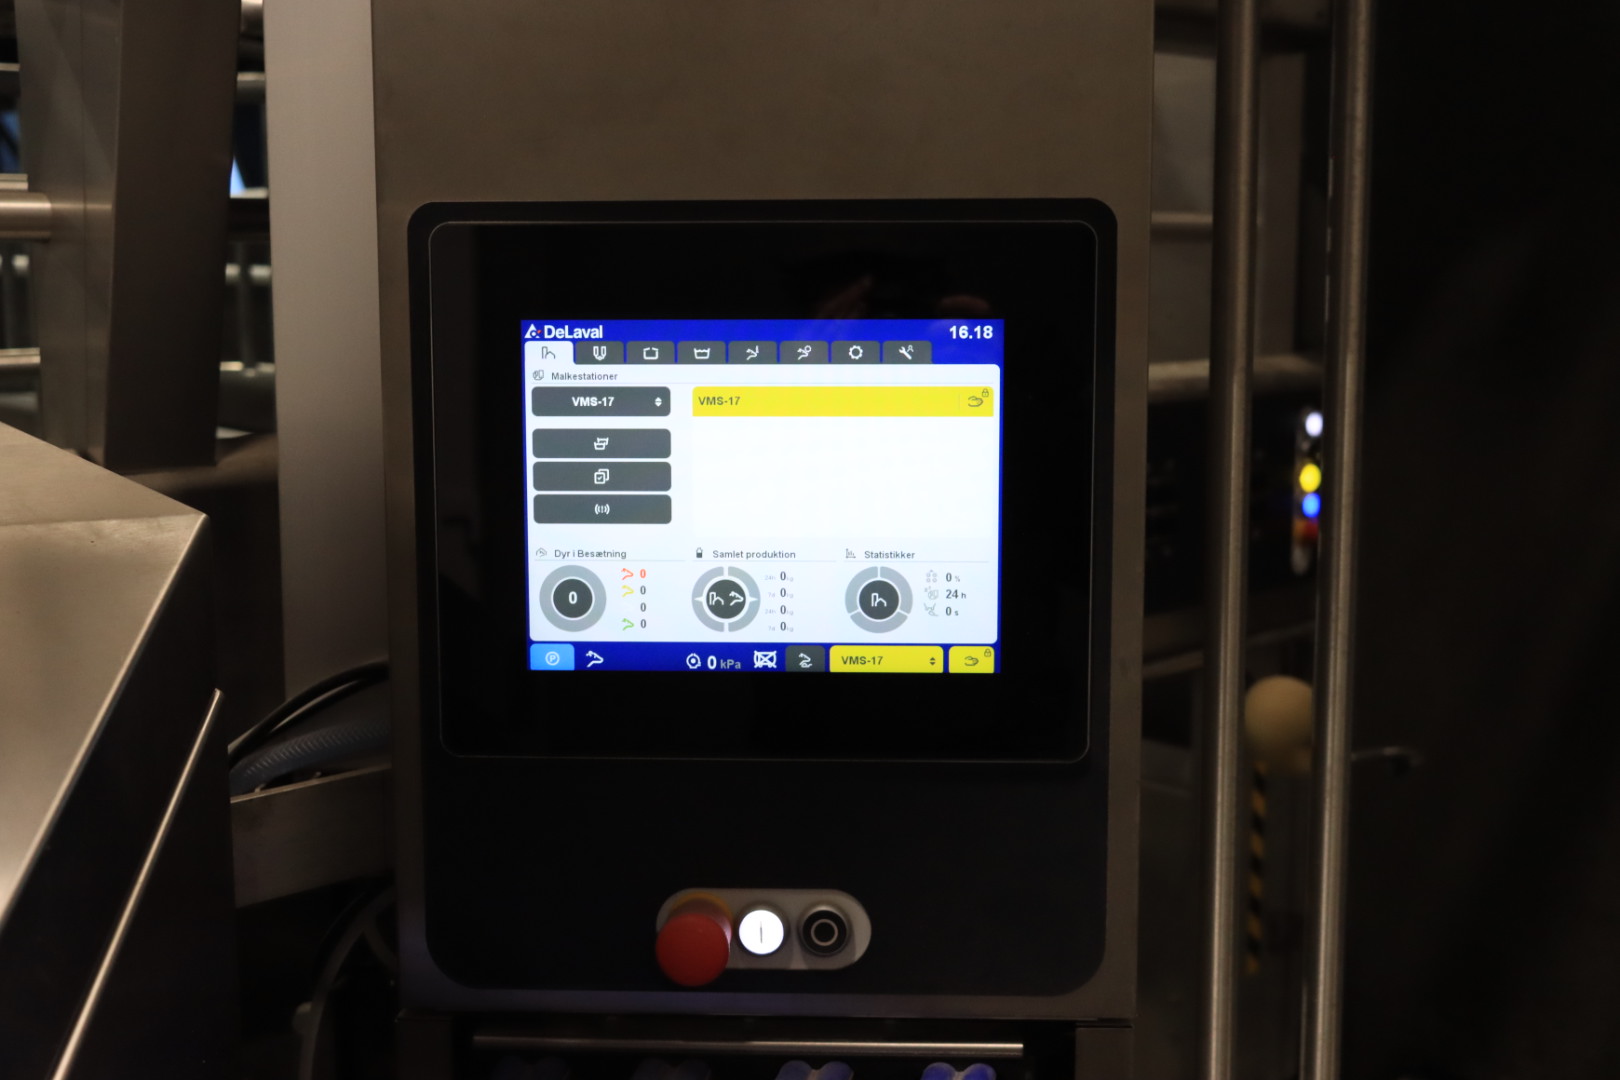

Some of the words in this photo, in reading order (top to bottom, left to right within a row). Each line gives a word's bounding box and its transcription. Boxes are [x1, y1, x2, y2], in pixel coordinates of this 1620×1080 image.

[544, 325, 603, 339] DeLaval
[949, 325, 993, 339] 16.18
[551, 371, 618, 381] Malkestationer
[572, 396, 615, 407] VMS-17
[698, 396, 741, 406] VMS-17
[554, 550, 571, 559] Dyr
[578, 549, 627, 559] Besætning
[713, 550, 744, 559] Samlet
[746, 550, 796, 560] produktion
[864, 550, 915, 559] Statistikker
[640, 569, 646, 578] 0
[780, 571, 786, 581] 0
[945, 572, 952, 582] 0
[640, 585, 646, 595] 0
[780, 588, 786, 598] 0
[945, 589, 959, 599] 24
[568, 591, 578, 605] 0
[640, 602, 646, 612] 0
[780, 605, 786, 615] 0
[945, 606, 952, 616] 0
[640, 619, 646, 629] 0
[780, 622, 786, 632] 0
[707, 655, 717, 669] 0
[720, 659, 741, 669] kPa
[841, 656, 883, 665] VMS-17
